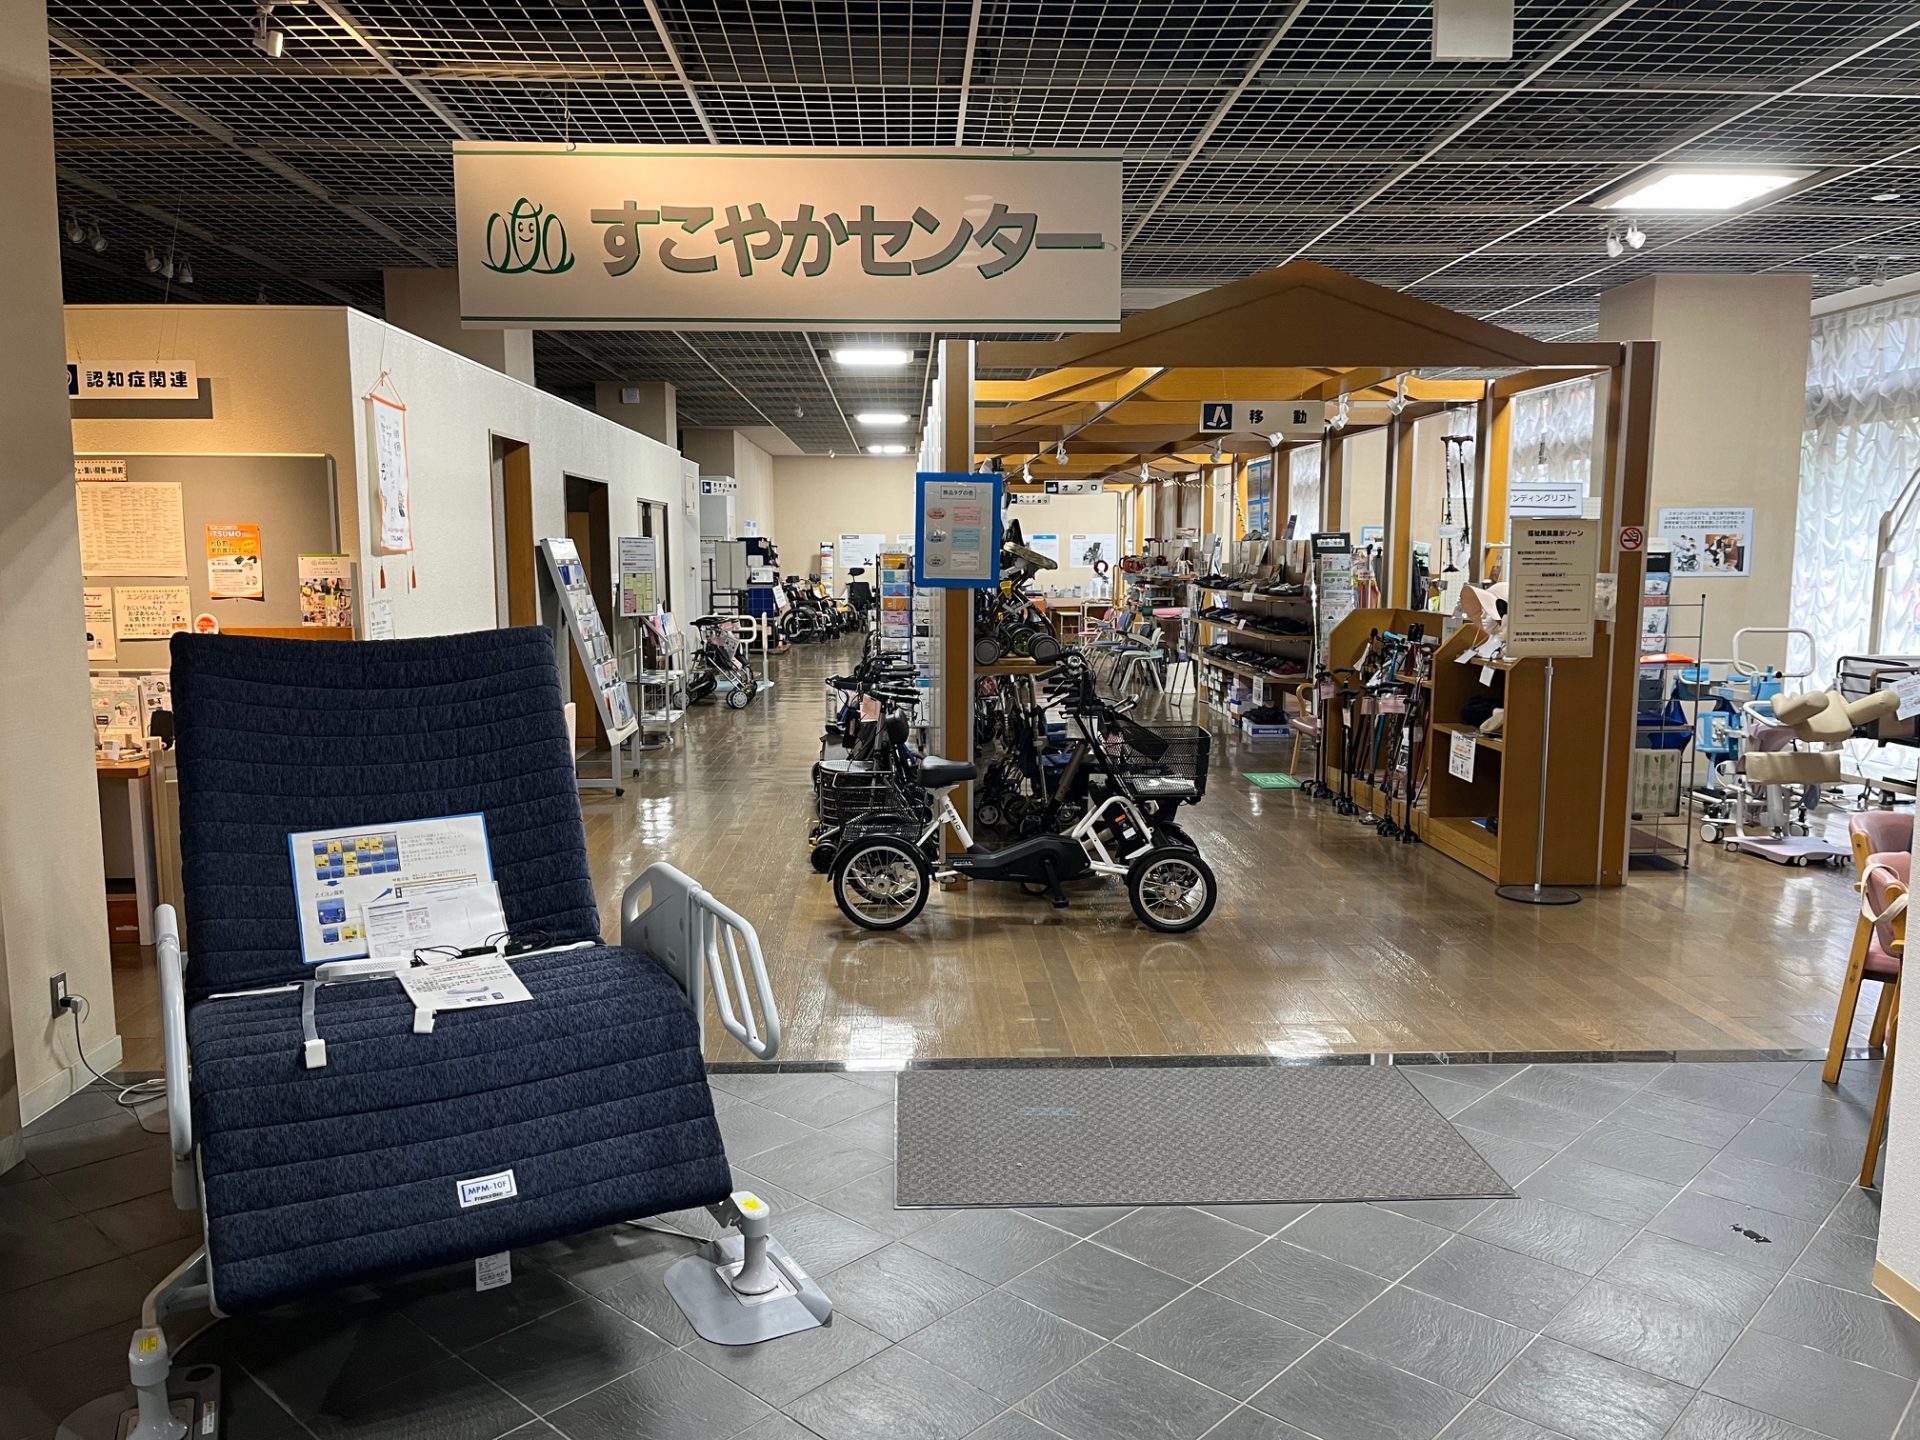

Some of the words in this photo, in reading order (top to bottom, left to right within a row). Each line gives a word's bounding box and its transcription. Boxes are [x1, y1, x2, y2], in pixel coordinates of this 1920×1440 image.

[590, 200, 1104, 279] すこやかセンター
[86, 370, 188, 388] 認知症関連
[467, 1180, 508, 1196] MPM-10F
